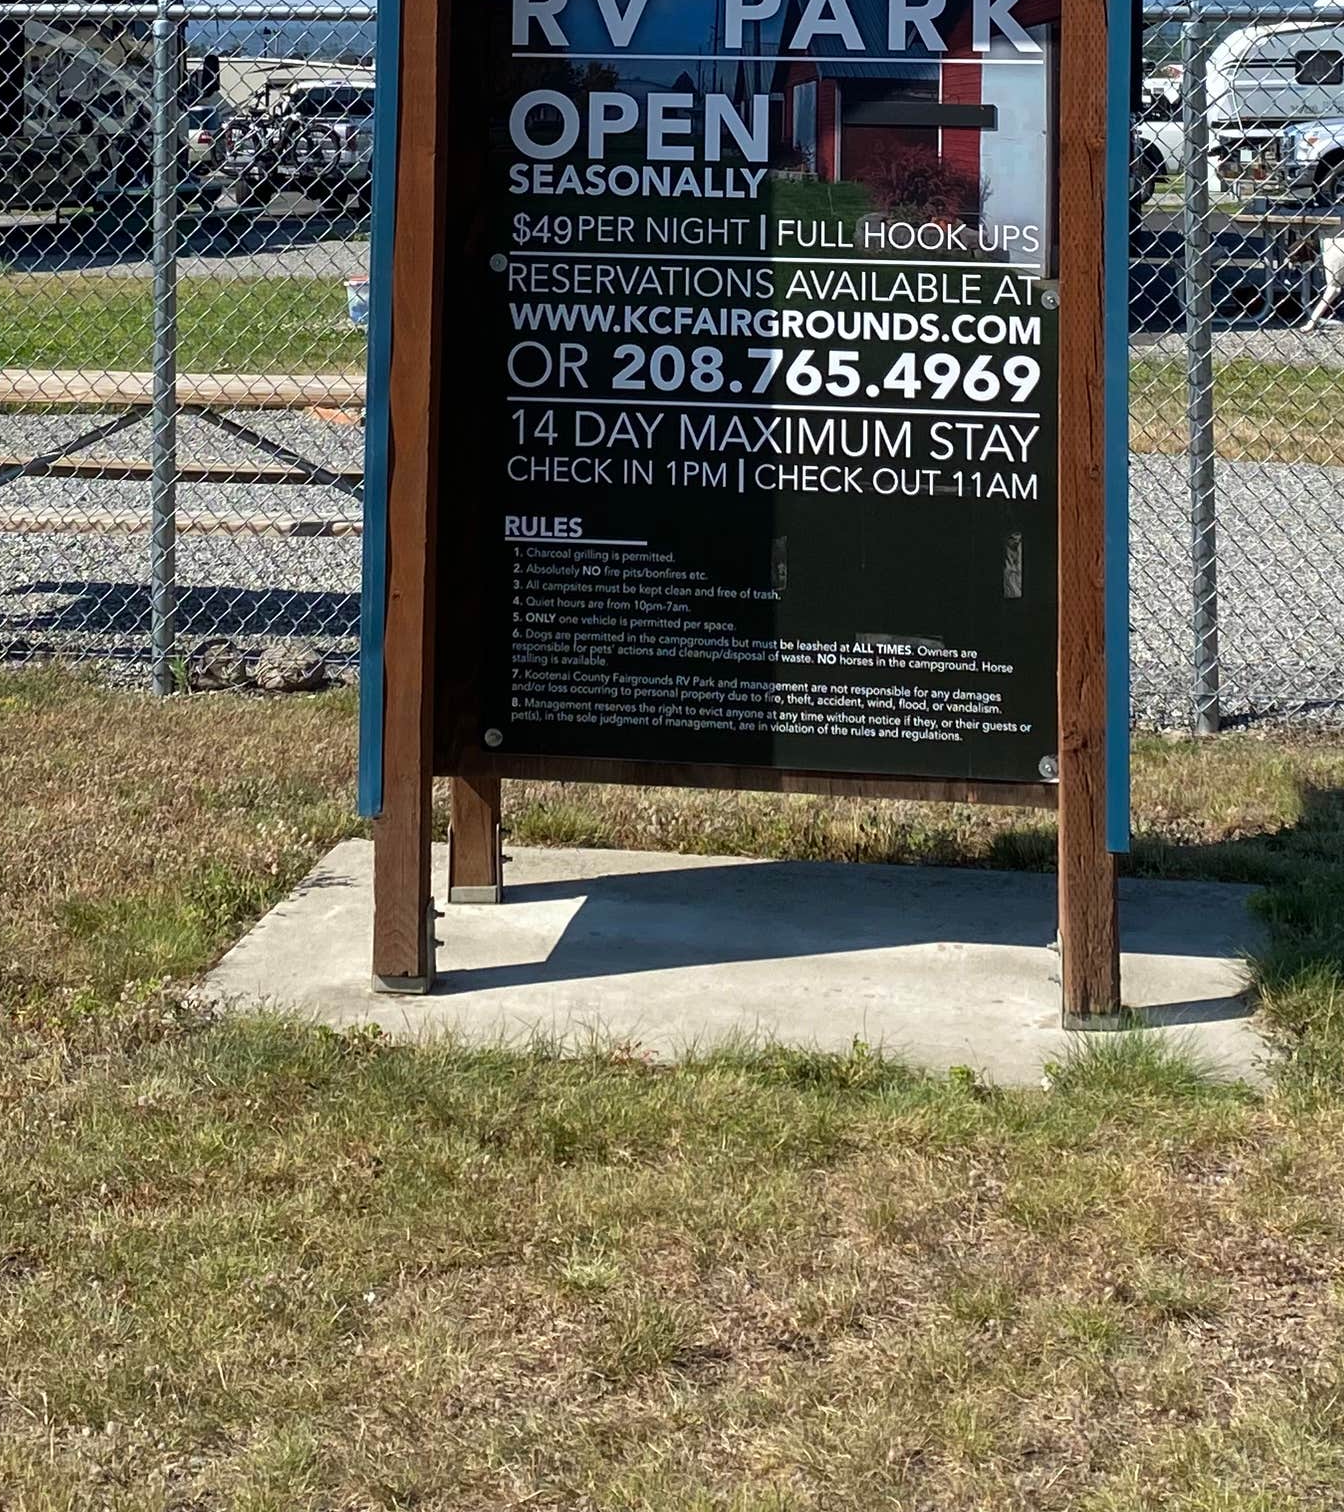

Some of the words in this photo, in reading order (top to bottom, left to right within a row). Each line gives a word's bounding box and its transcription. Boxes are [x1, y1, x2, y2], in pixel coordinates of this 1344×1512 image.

[508, 88, 769, 165] OPEN
[508, 162, 769, 200] SEASONALLY
[511, 211, 573, 247] $49
[577, 214, 635, 243] PER
[646, 216, 749, 246] NIGHT
[777, 219, 853, 248] FULL
[863, 220, 966, 251] HOOK
[977, 222, 1040, 253] UPS
[508, 261, 775, 300] RESERVATIONS
[784, 268, 982, 305] AVAILABLE
[992, 273, 1040, 307] AT
[509, 301, 1041, 346] WWW.KCFAIRGROUNDS.COM
[507, 340, 589, 390] OR
[611, 342, 1041, 404] 208.765.4969
[510, 408, 559, 447] 14
[574, 409, 664, 450] DAY
[679, 413, 911, 459] MAXIMUM
[928, 420, 1040, 463] STAY
[506, 454, 613, 485] CHECK
[622, 459, 653, 486] IN
[666, 460, 728, 489] 1PM
[754, 462, 864, 495] CHECK
[871, 466, 941, 497] OUT
[952, 470, 1038, 500] 11AM
[504, 514, 584, 540] RULES
[525, 547, 571, 558] Charcoal
[573, 549, 609, 562] grilling
[611, 550, 620, 560] is
[525, 563, 580, 577] Absolutely
[581, 565, 601, 576] NO
[603, 566, 621, 576] fire
[525, 579, 540, 589] All
[541, 580, 593, 594] campsites
[594, 582, 620, 593] must
[622, 583, 636, 594] be
[638, 584, 662, 597] kept
[663, 585, 692, 596] clean
[694, 586, 714, 597] and
[716, 587, 737, 598] free
[738, 588, 751, 598] of
[525, 595, 555, 606] Quiet
[556, 596, 586, 607] hours
[587, 599, 604, 608] are
[606, 598, 631, 609] from
[524, 611, 556, 623] ONLY
[558, 615, 579, 624] one
[580, 614, 617, 625] vehicle
[618, 615, 628, 626] is
[629, 616, 681, 630] permitted
[682, 620, 701, 631] per
[524, 628, 553, 641] Dogs
[554, 631, 571, 640] are
[573, 630, 625, 644] permitted
[626, 632, 636, 643] in
[638, 633, 656, 643] the
[657, 634, 729, 649] campgrounds
[731, 637, 749, 648] but
[751, 638, 777, 649] must
[779, 639, 794, 650] be
[796, 640, 837, 652] leashed
[838, 642, 850, 652] at
[851, 642, 874, 653] ALL
[916, 645, 958, 657] Owners
[960, 649, 977, 658] are
[816, 653, 837, 664] NO
[838, 654, 874, 666] horses
[875, 656, 886, 666] in
[888, 656, 906, 667] the
[981, 660, 1013, 672] Horse
[572, 670, 611, 684] County
[612, 672, 674, 687] Fairgrounds
[675, 675, 690, 686] RV
[692, 676, 715, 687] Park
[717, 677, 738, 688] and
[739, 678, 808, 694] management
[810, 684, 828, 692] are
[829, 682, 848, 693] not
[850, 683, 911, 699] responsible
[912, 686, 929, 697] for
[930, 689, 950, 700] any
[951, 688, 1002, 703] damages
[524, 697, 592, 713] Management
[593, 703, 637, 713] reserves
[638, 703, 656, 714] the
[657, 704, 682, 717] right
[684, 705, 696, 715] to
[698, 706, 723, 717] evict
[725, 709, 764, 721] anyone
[766, 709, 777, 719] at
[778, 711, 798, 723] any
[799, 710, 824, 722] time
[825, 712, 866, 724] without
[867, 714, 901, 725] notice
[903, 715, 911, 726] if
[940, 719, 953, 728] or
[954, 718, 980, 729] their
[981, 719, 1017, 733] guests
[1019, 723, 1032, 732] or
[931, 701, 944, 710] or
[769, 721, 814, 733] violation
[816, 723, 829, 734] of
[830, 724, 848, 735] the
[850, 725, 876, 736] rules
[877, 726, 899, 738] and
